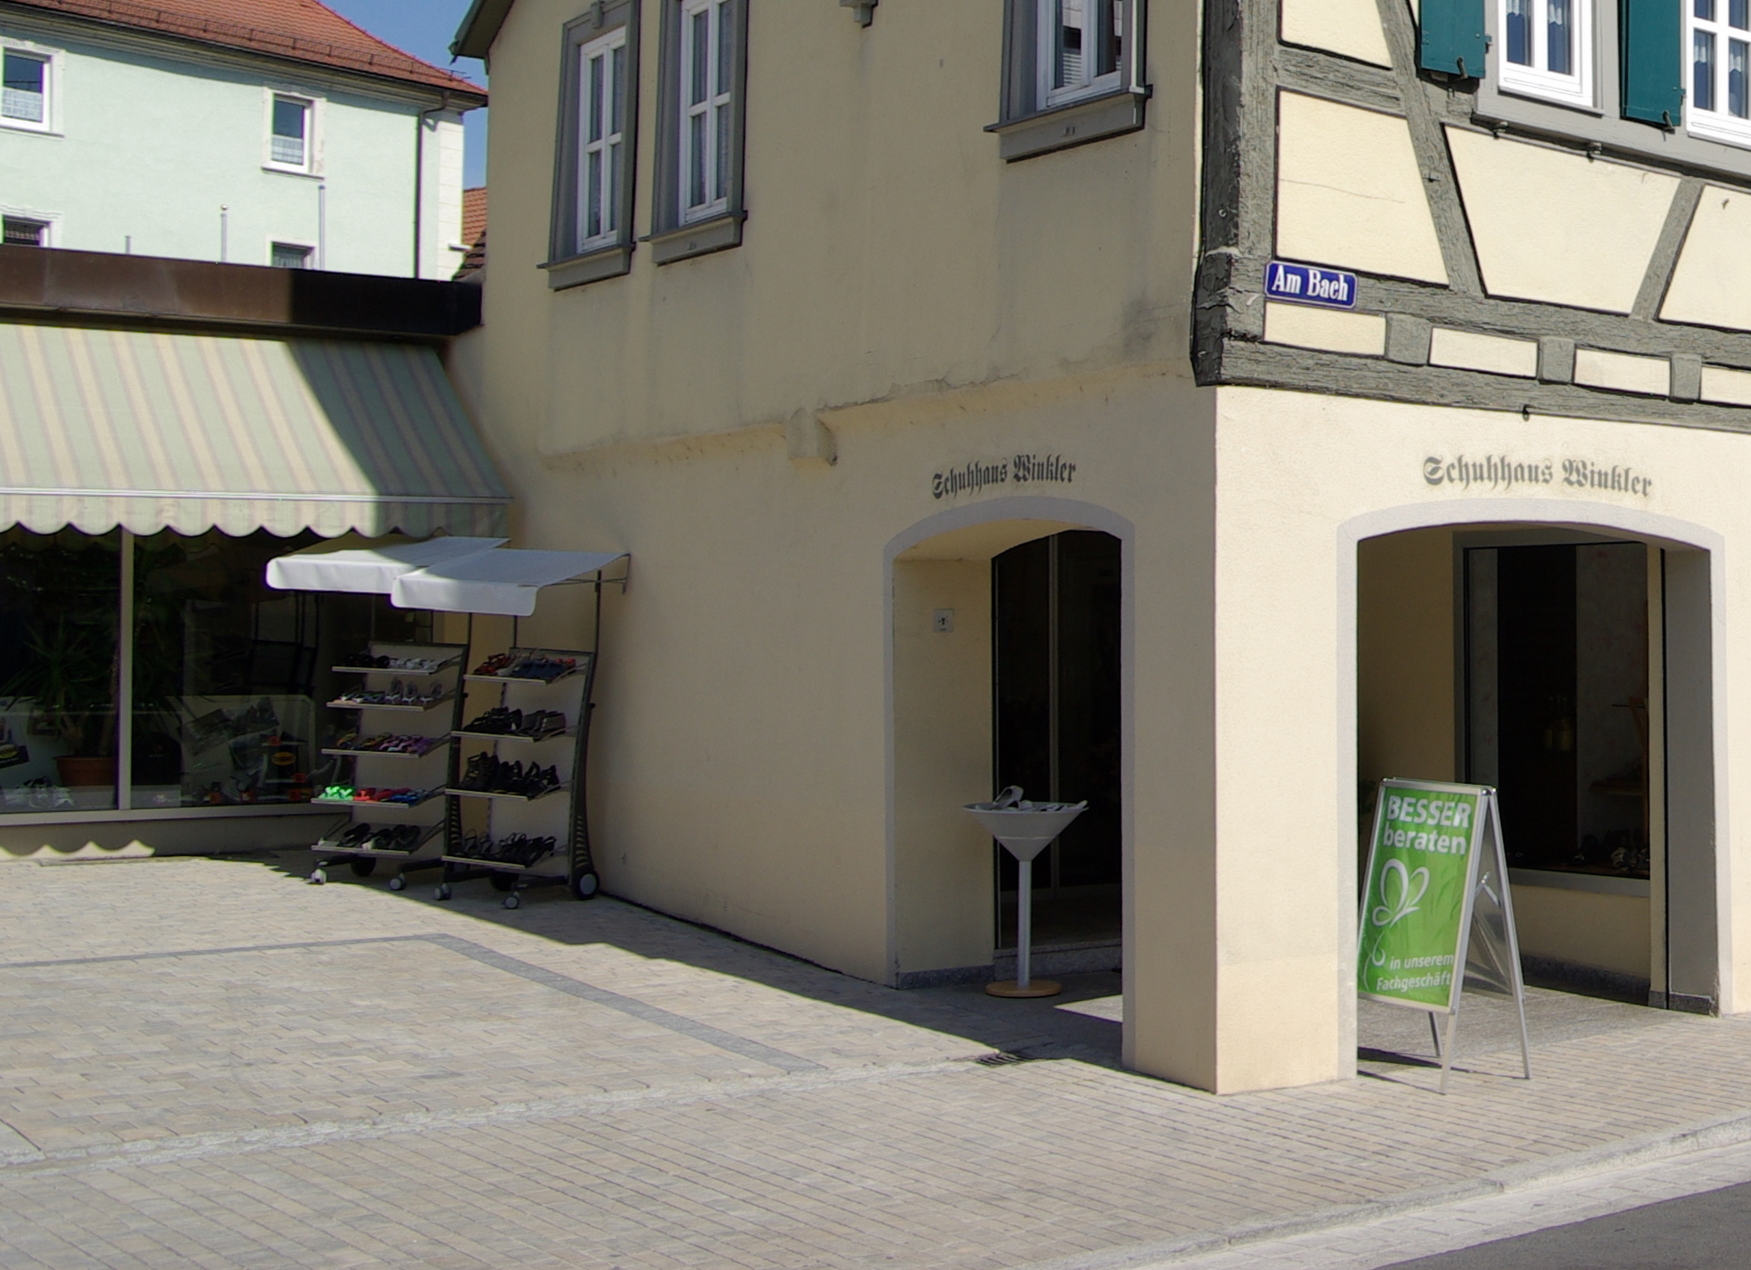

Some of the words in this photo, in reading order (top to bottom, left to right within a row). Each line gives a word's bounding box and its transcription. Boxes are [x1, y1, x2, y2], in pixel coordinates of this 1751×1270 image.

[1272, 265, 1300, 294] Am
[1307, 269, 1348, 301] Bach
[931, 457, 1008, 500] Schuhhaus
[1013, 454, 1077, 484] Winkler
[1422, 454, 1553, 491] Schuhhaus
[1562, 458, 1652, 497] Winkler
[1387, 795, 1471, 828] BESSER
[1383, 821, 1466, 855] beraten
[1389, 956, 1401, 970] in
[1404, 954, 1454, 969] unserem
[1376, 970, 1452, 993] Fachgeschäft
